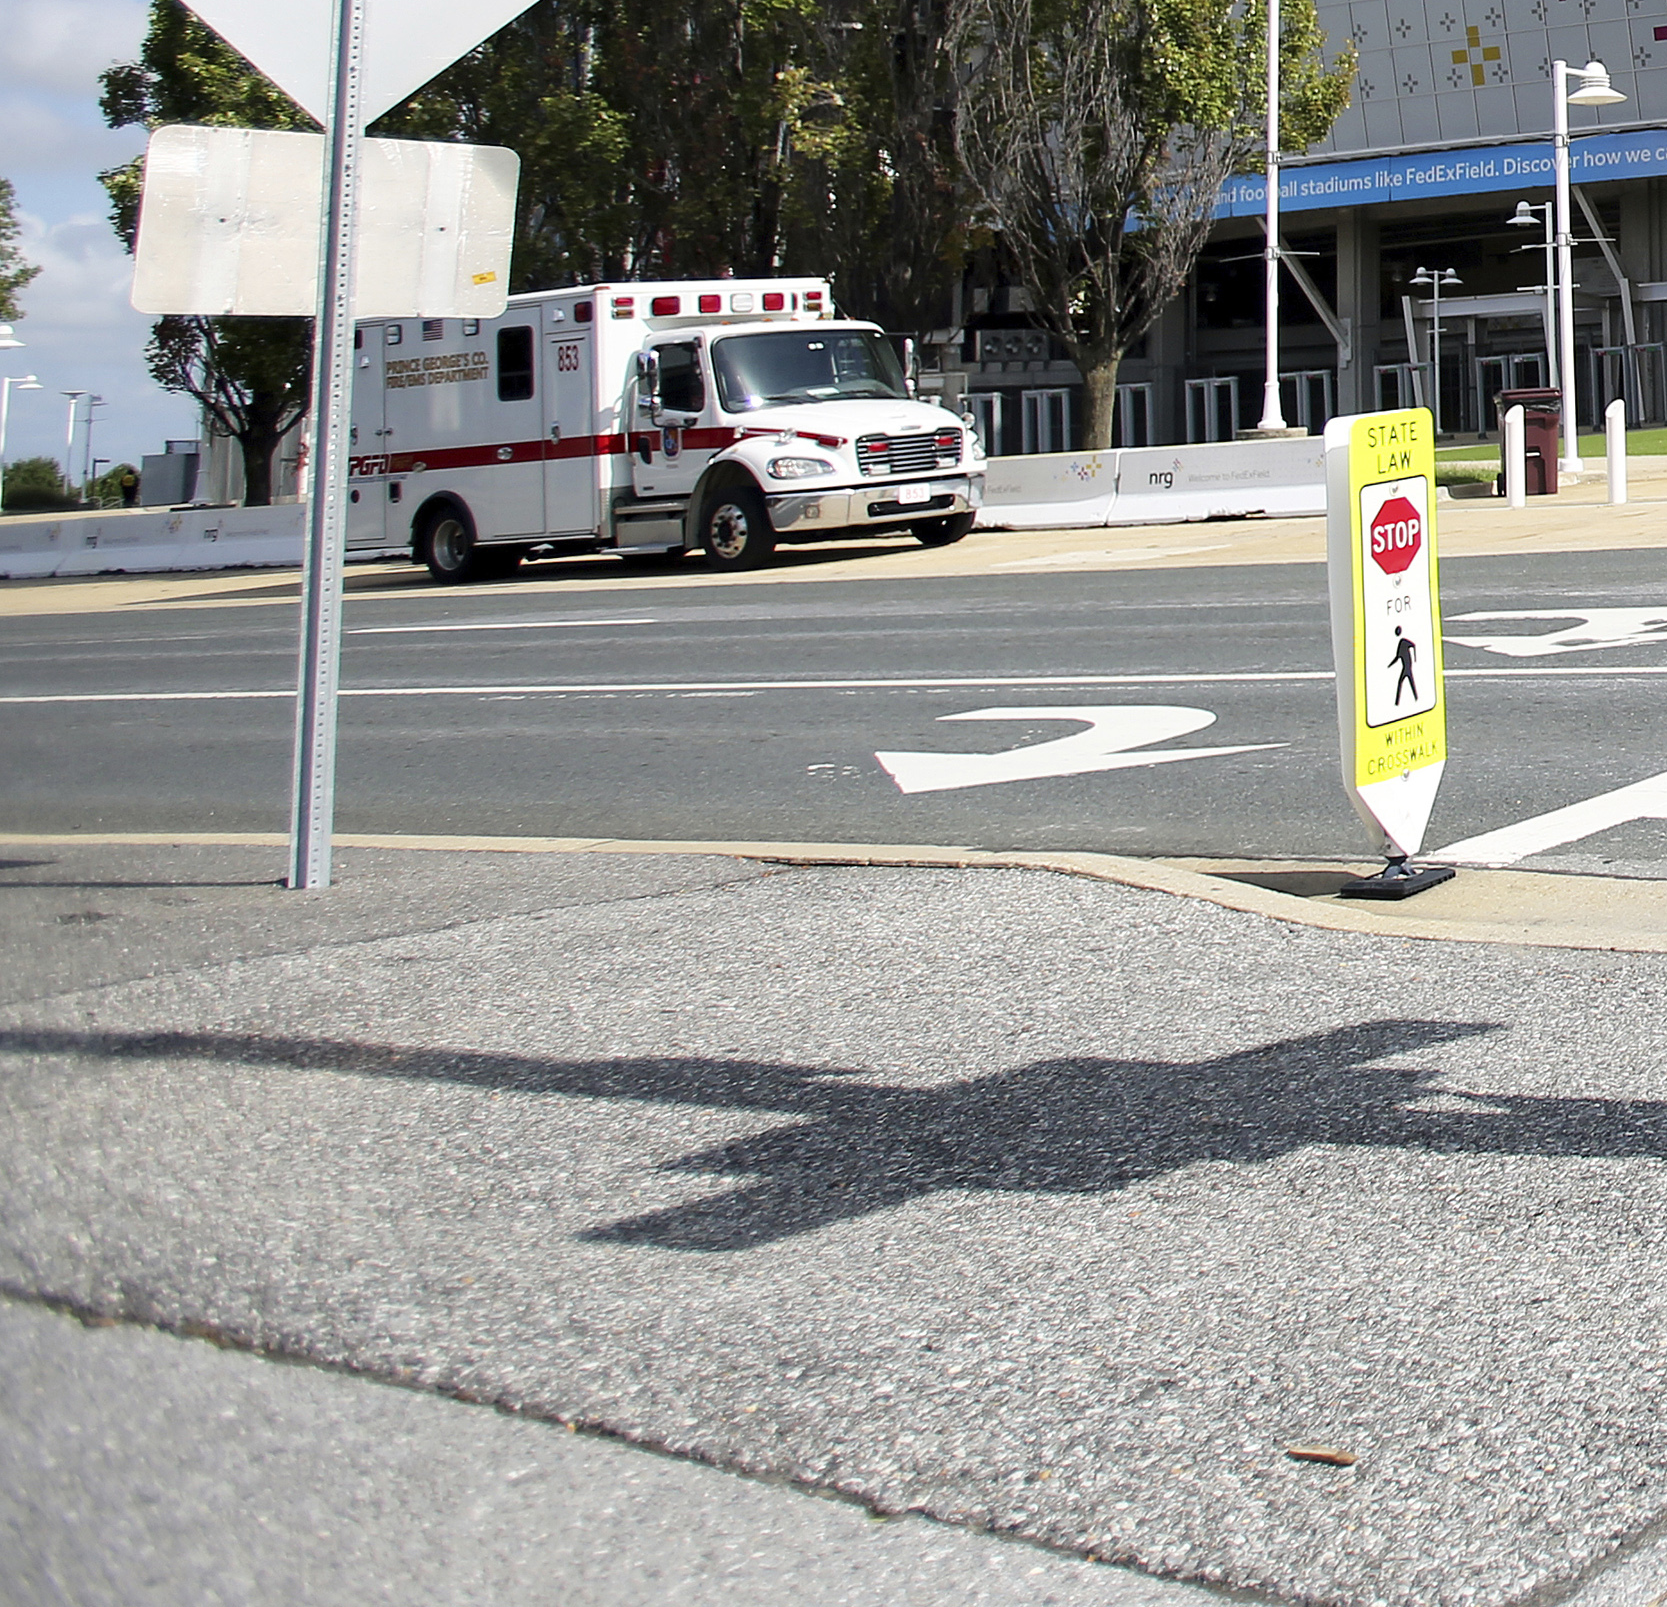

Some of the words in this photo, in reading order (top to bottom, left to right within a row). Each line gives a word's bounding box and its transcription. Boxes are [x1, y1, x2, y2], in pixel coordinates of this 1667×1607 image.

[1301, 174, 1371, 196] stadiums
[1375, 170, 1402, 188] like
[1406, 160, 1499, 185] FedExField.
[1584, 151, 1621, 167] how
[1625, 148, 1651, 163] we
[386, 358, 420, 375] PRINCE
[422, 352, 470, 371] GEORGE'S
[471, 351, 489, 366] CO.
[557, 345, 579, 372] 853
[386, 372, 426, 390] FIRE/EMS
[427, 366, 489, 385] DEPARTMENT
[1367, 421, 1418, 448] STATE
[1377, 450, 1411, 475] LAW
[1149, 471, 1173, 489] nrg
[1372, 518, 1420, 554] STOP
[1386, 595, 1412, 616] FOR
[1385, 722, 1424, 747] WITHIN
[1367, 740, 1438, 776] CROSSWALK
